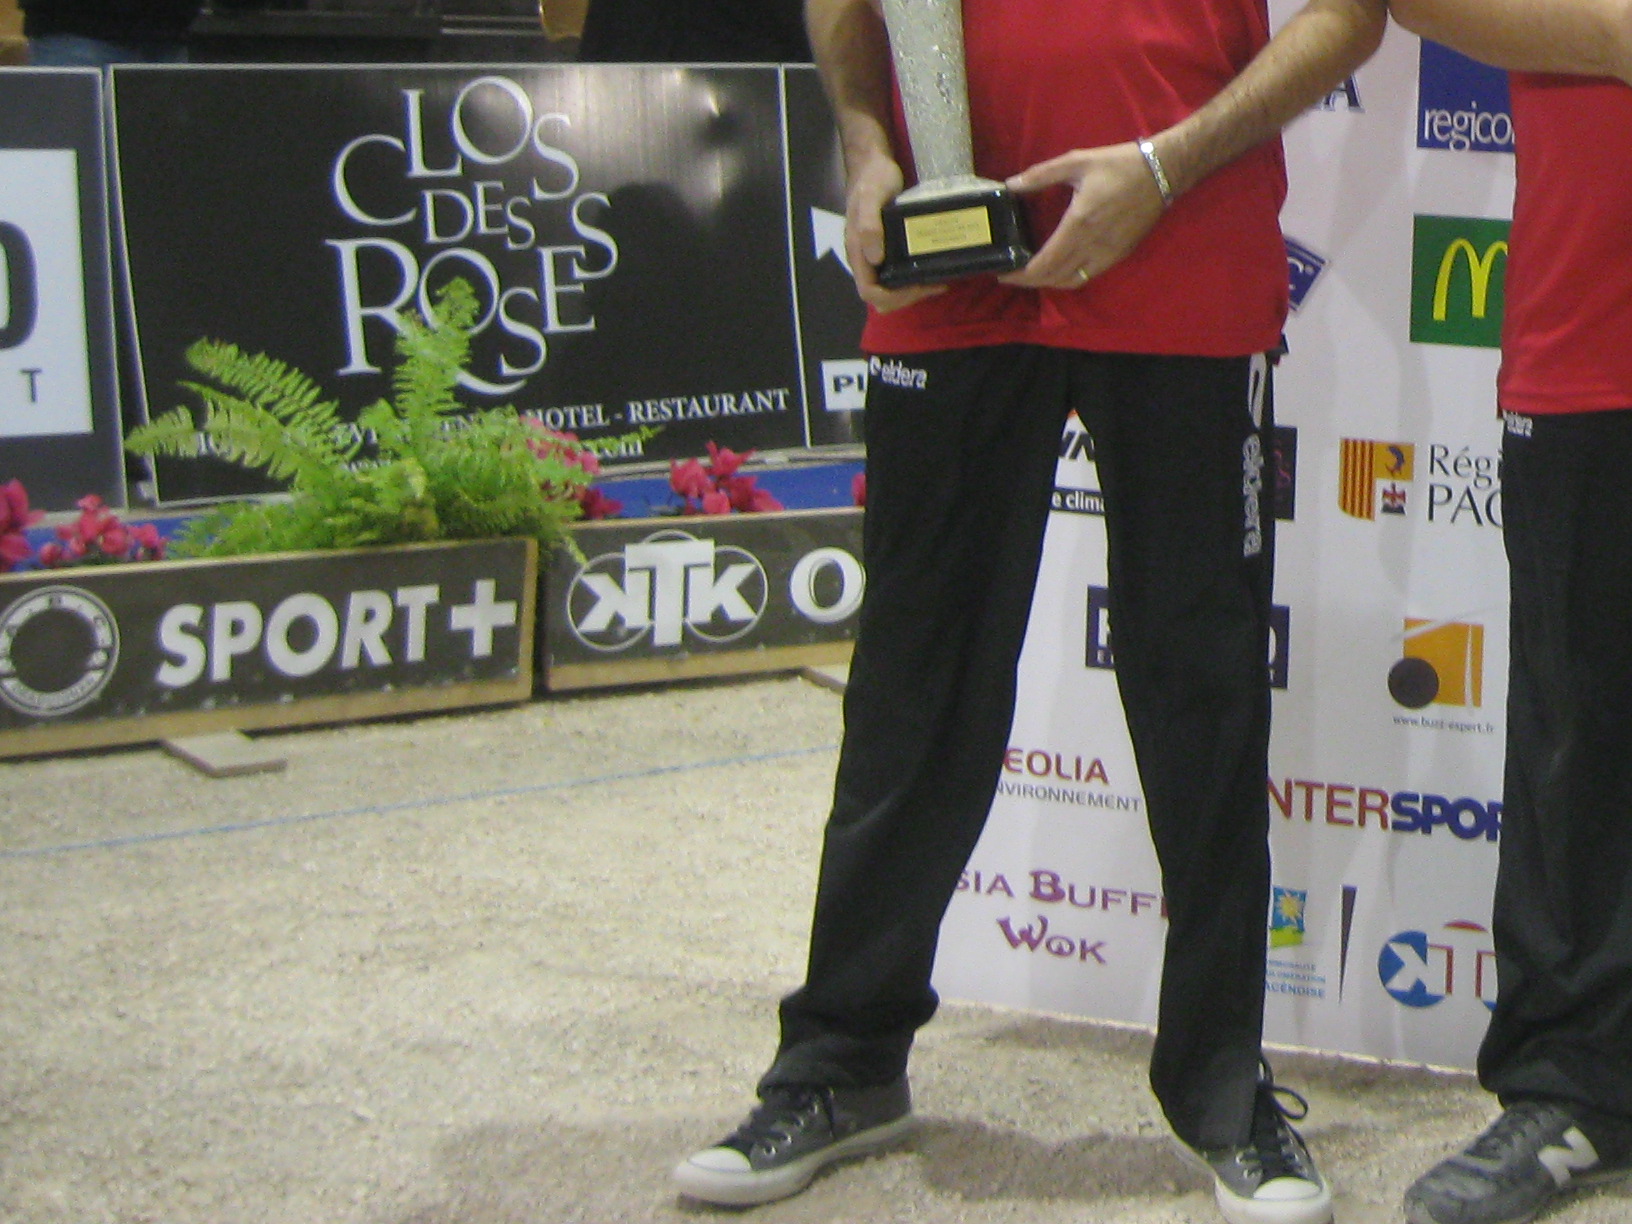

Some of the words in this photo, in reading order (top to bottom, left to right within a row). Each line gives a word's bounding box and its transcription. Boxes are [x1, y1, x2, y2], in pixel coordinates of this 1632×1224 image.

[332, 75, 580, 226] CLOS
[1424, 101, 1515, 151] regico
[422, 180, 536, 251] DES
[627, 387, 790, 424] RESTAURANT
[155, 586, 441, 688] SPORT
[996, 914, 1107, 965] WOK
